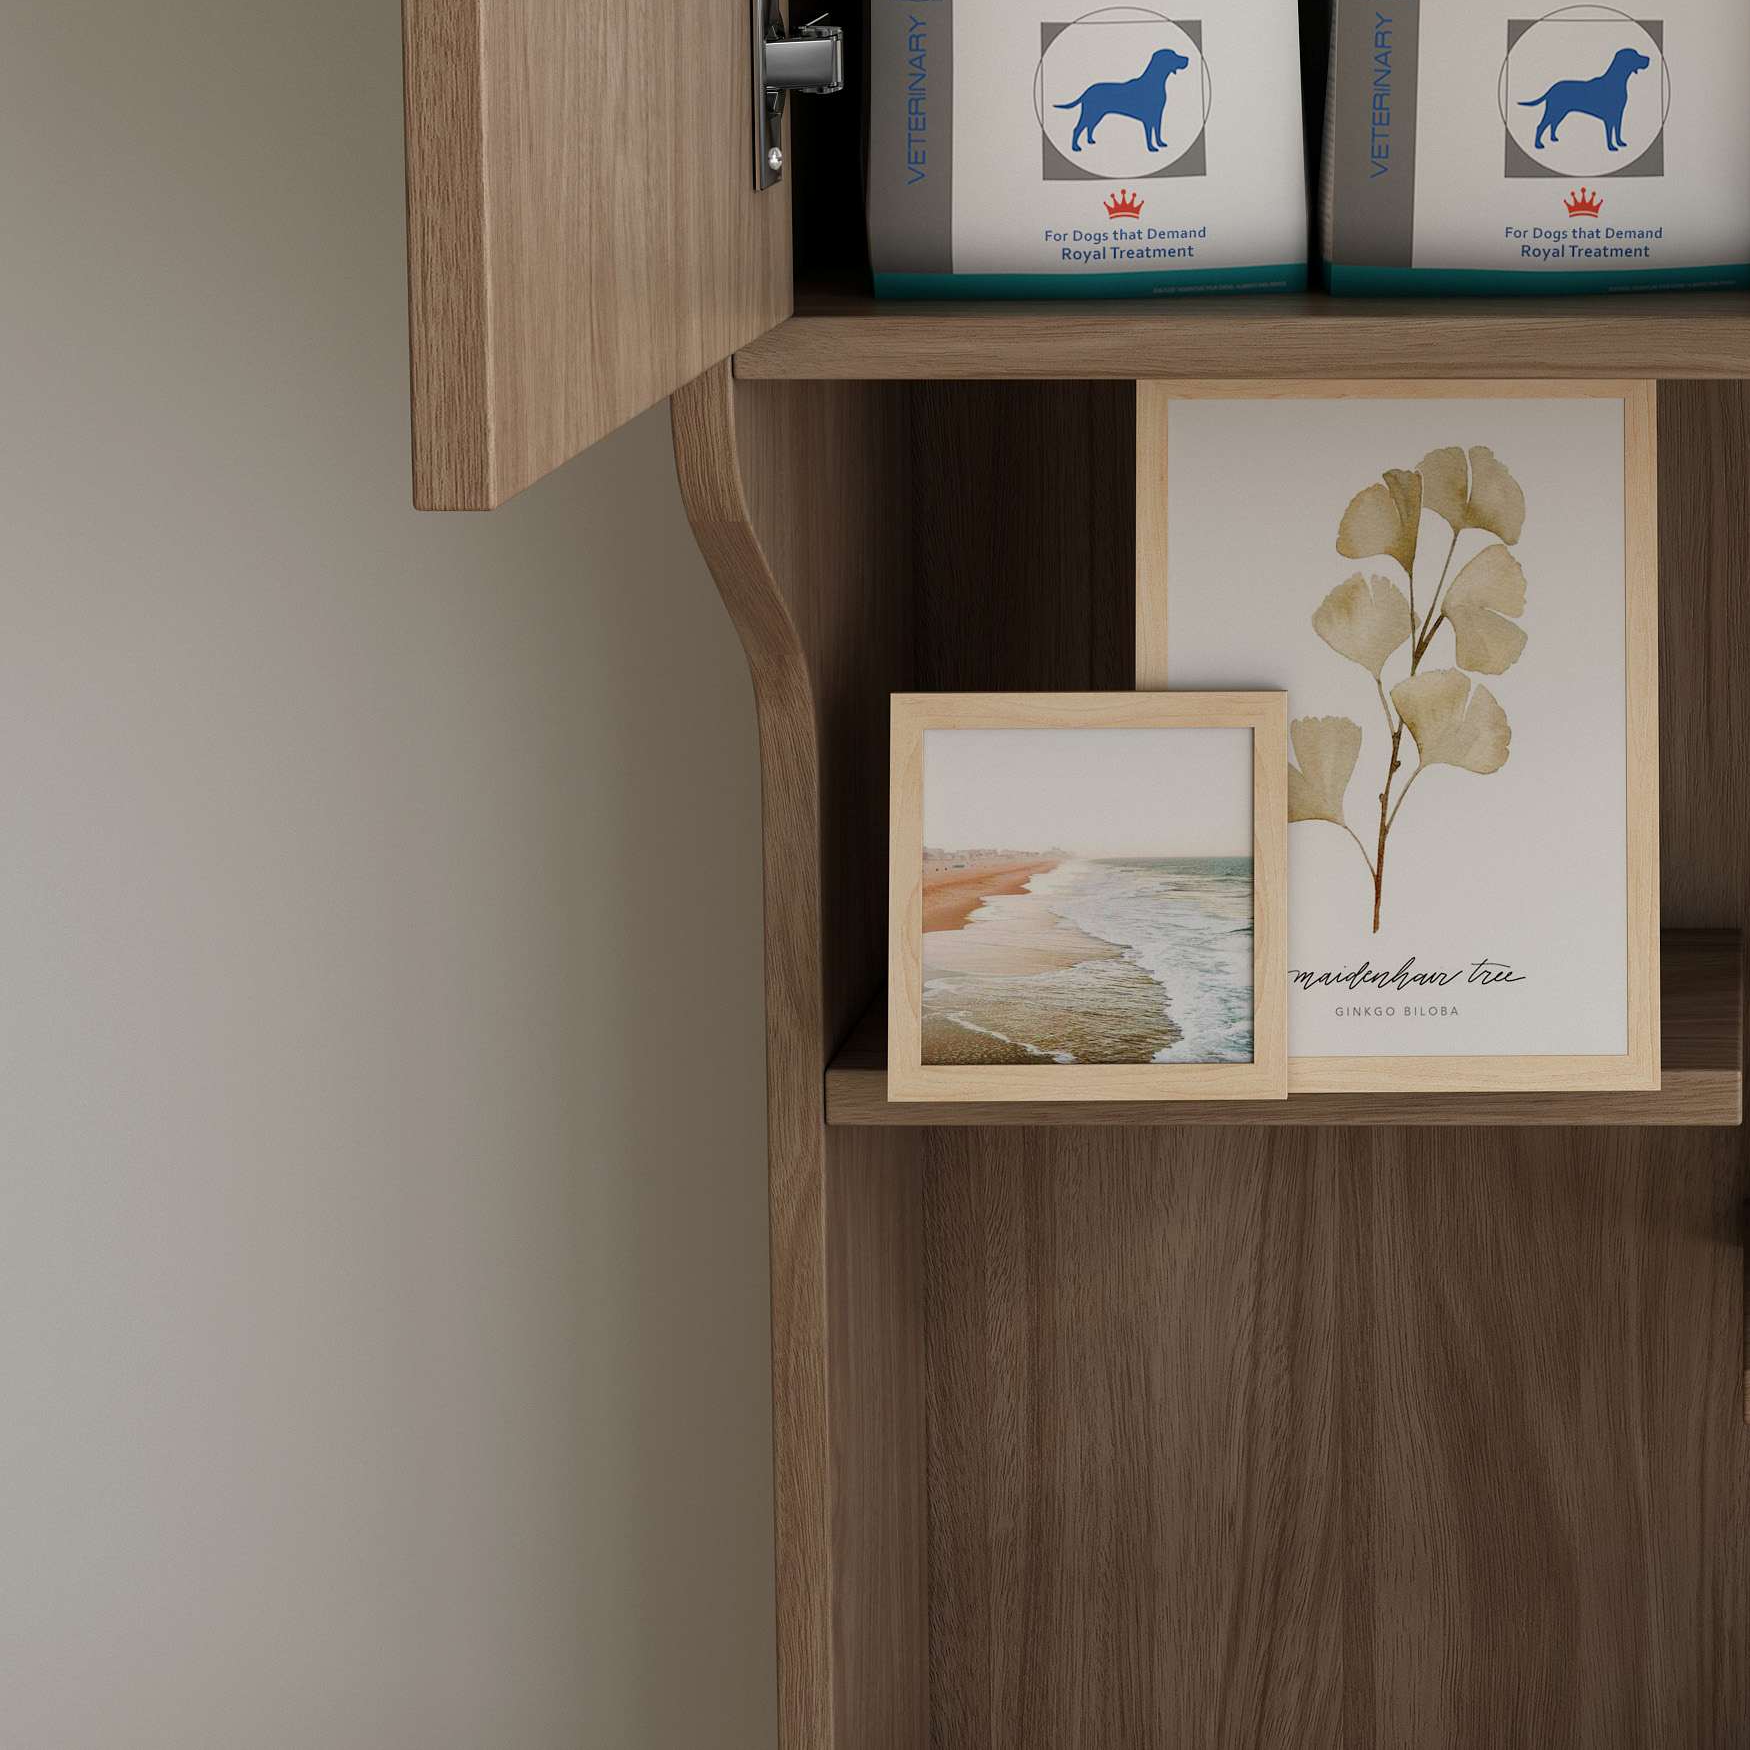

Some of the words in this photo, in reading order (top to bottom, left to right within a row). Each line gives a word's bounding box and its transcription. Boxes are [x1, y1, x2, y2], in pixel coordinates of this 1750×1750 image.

[907, 15, 927, 186] VETERINARY
[1370, 11, 1393, 179] VETERINARY
[1045, 230, 1068, 241] For
[1073, 230, 1108, 244] Dogs
[1112, 229, 1143, 241] that
[1148, 226, 1206, 239] Demand
[1506, 227, 1528, 238] For
[1533, 227, 1568, 242] Dogs
[1571, 227, 1601, 239] that
[1605, 227, 1662, 239] Demand
[1062, 247, 1105, 263] Royal
[1110, 246, 1194, 259] Treatment
[1522, 244, 1564, 261] Royal
[1569, 245, 1649, 258] Treatment
[1288, 957, 1463, 990] maidenhair
[1467, 958, 1526, 985] tree
[1335, 1007, 1396, 1017] GINKGO
[1404, 1007, 1459, 1017] BILOBA
